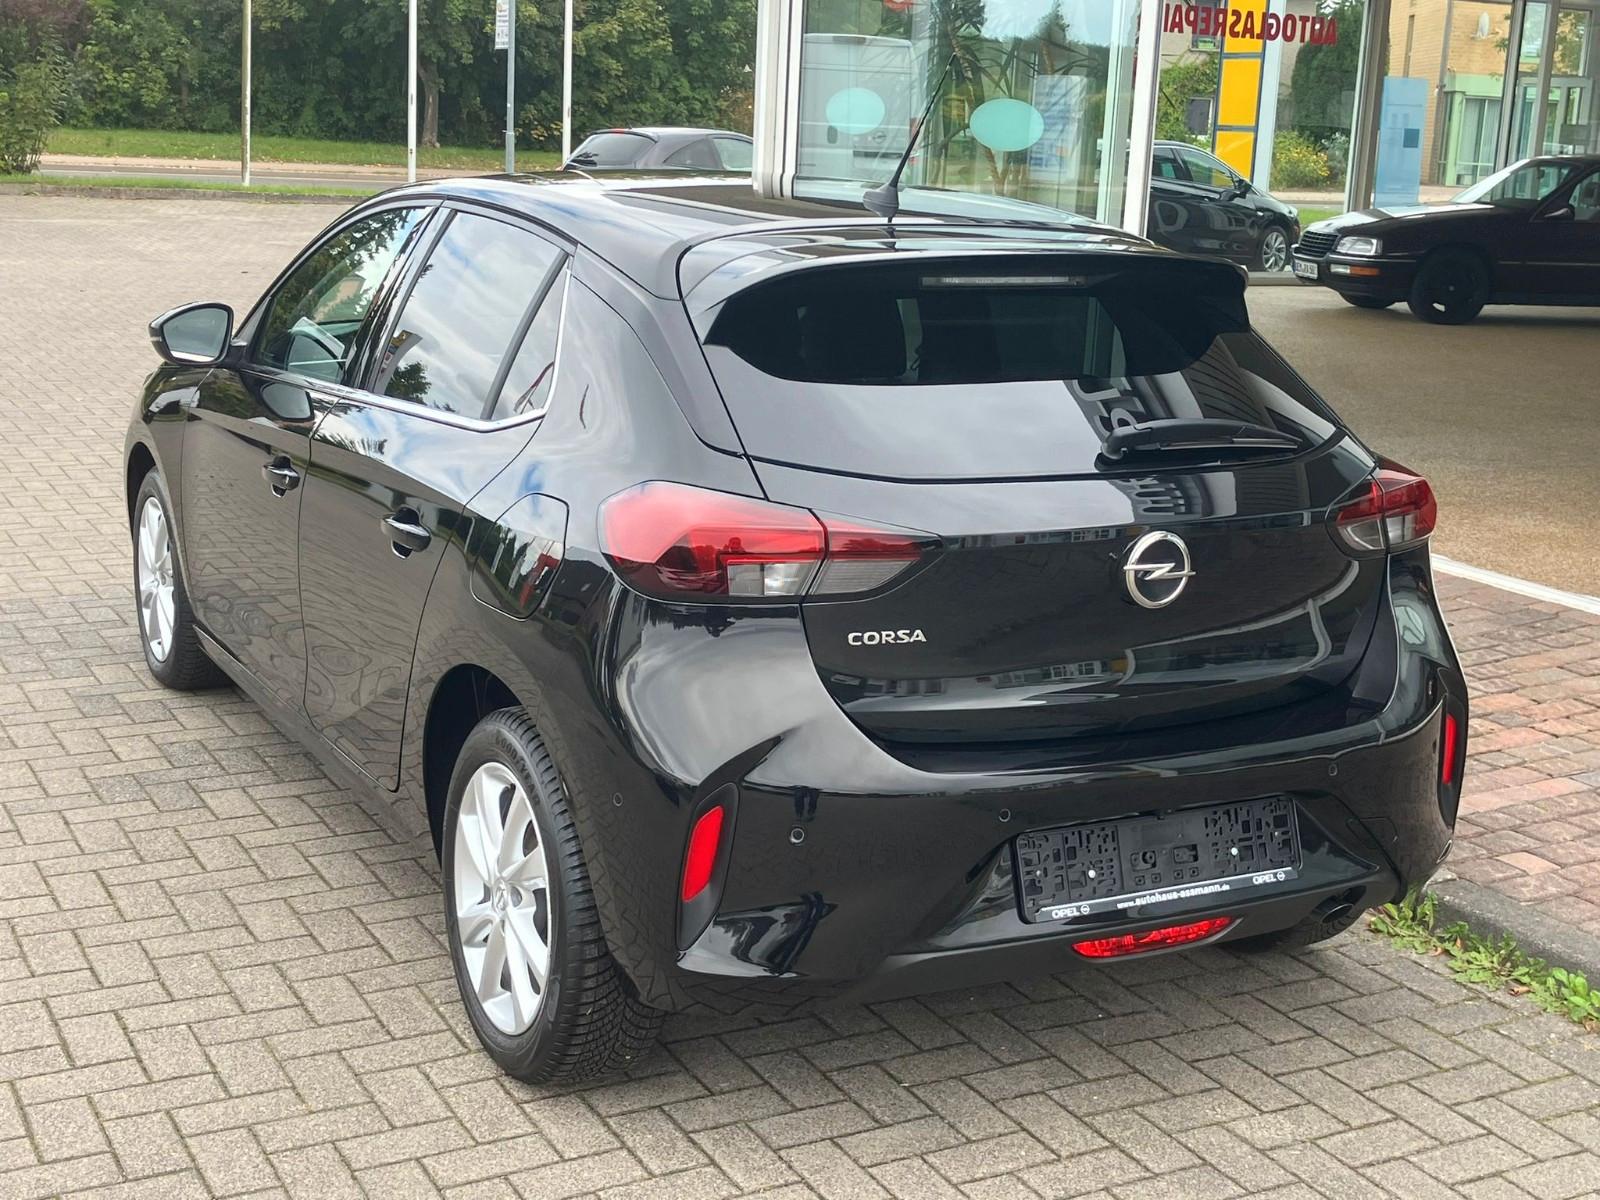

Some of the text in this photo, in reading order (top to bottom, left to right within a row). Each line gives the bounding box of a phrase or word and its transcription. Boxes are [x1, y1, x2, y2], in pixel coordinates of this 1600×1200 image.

[847, 629, 927, 646] CORSA
[1252, 873, 1277, 885] OPEL
[1116, 883, 1231, 909] www.autohaus-assmann.de
[1051, 906, 1081, 919] OPEL
